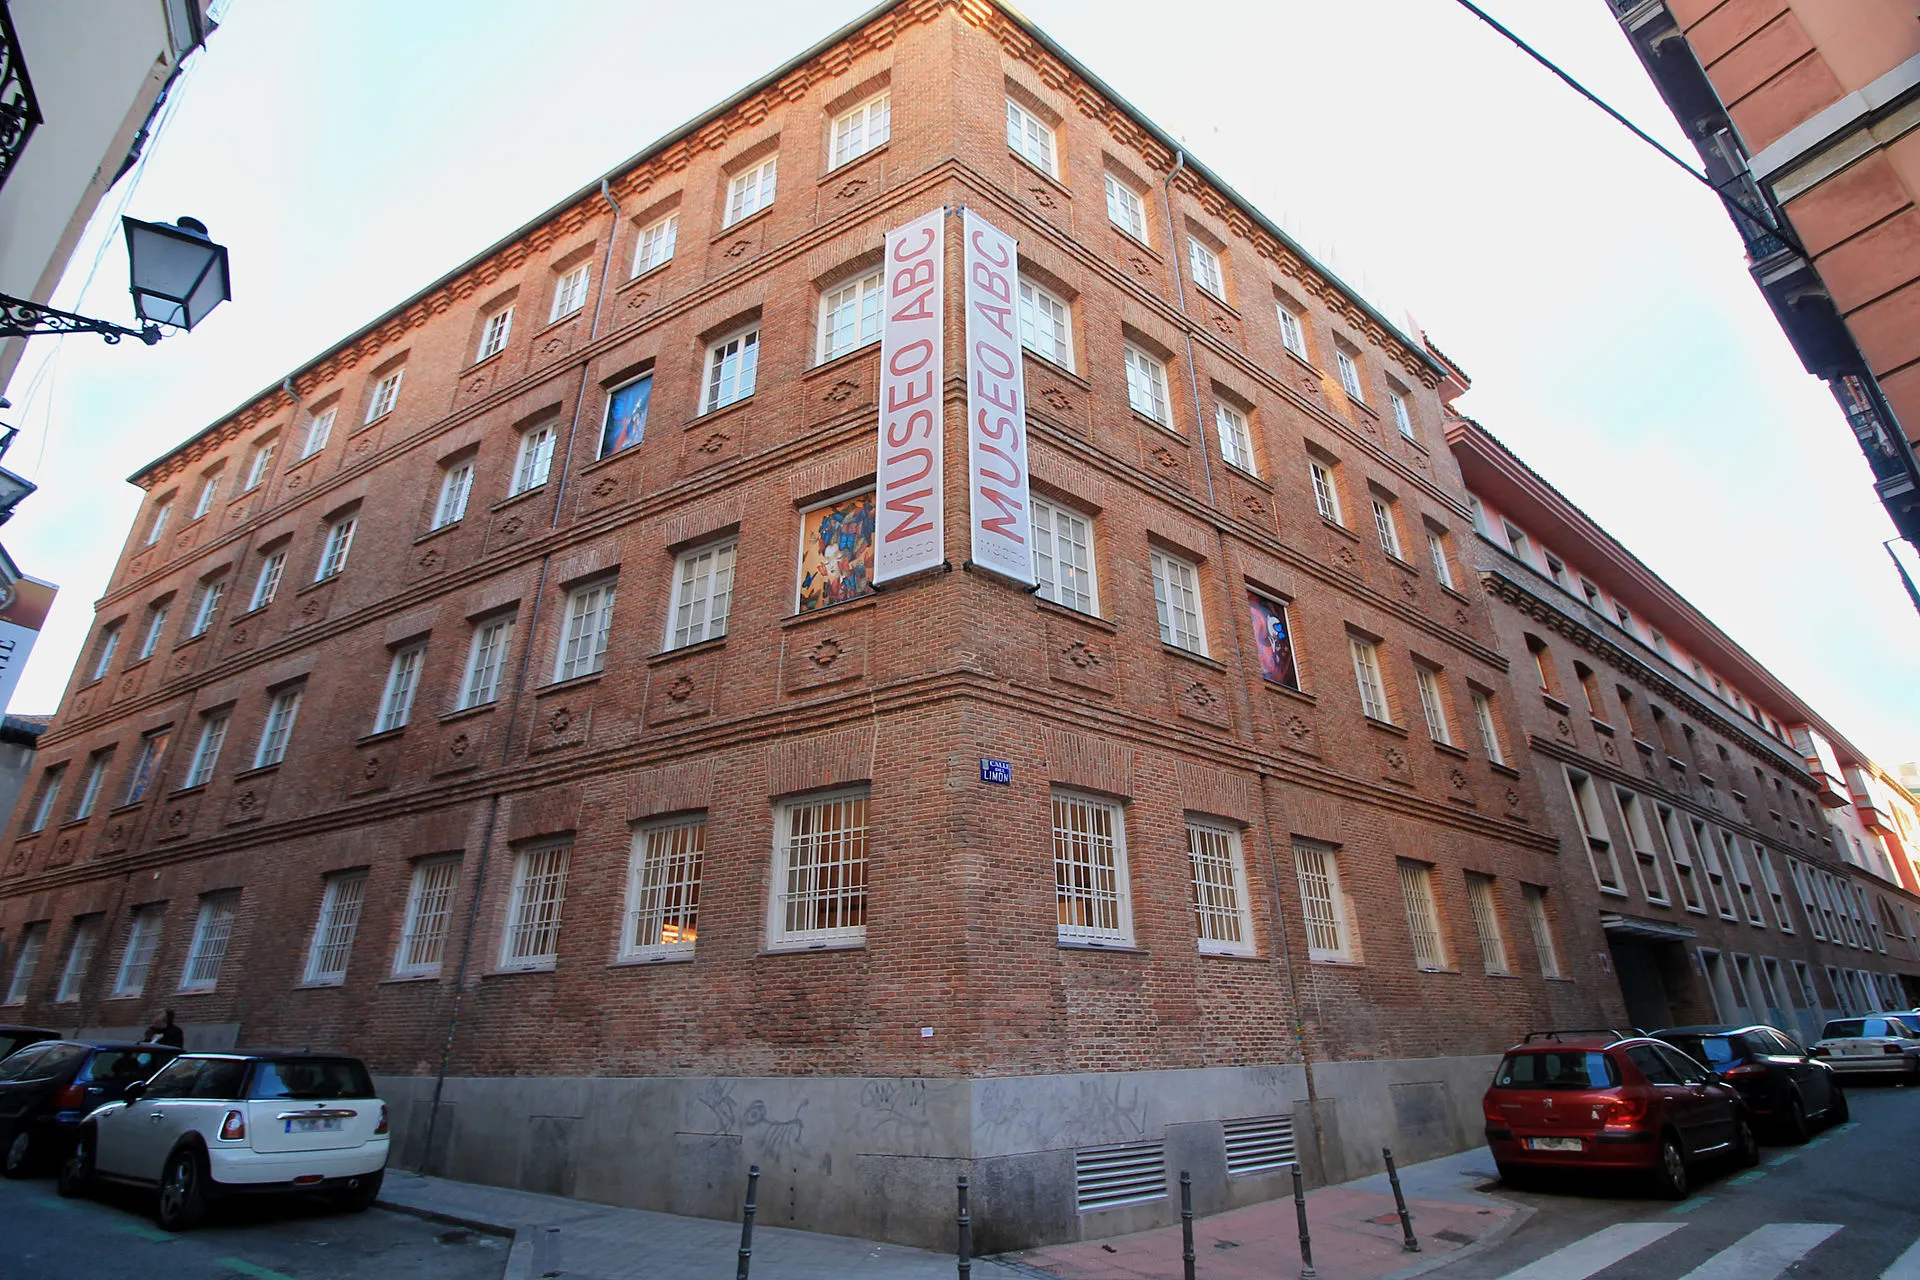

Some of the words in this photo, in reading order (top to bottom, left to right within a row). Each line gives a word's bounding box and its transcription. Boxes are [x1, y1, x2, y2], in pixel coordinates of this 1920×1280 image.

[891, 227, 935, 323] ABC
[971, 229, 1012, 339] ABC
[884, 338, 934, 544] MUSEO
[976, 340, 1025, 546] MUSEO
